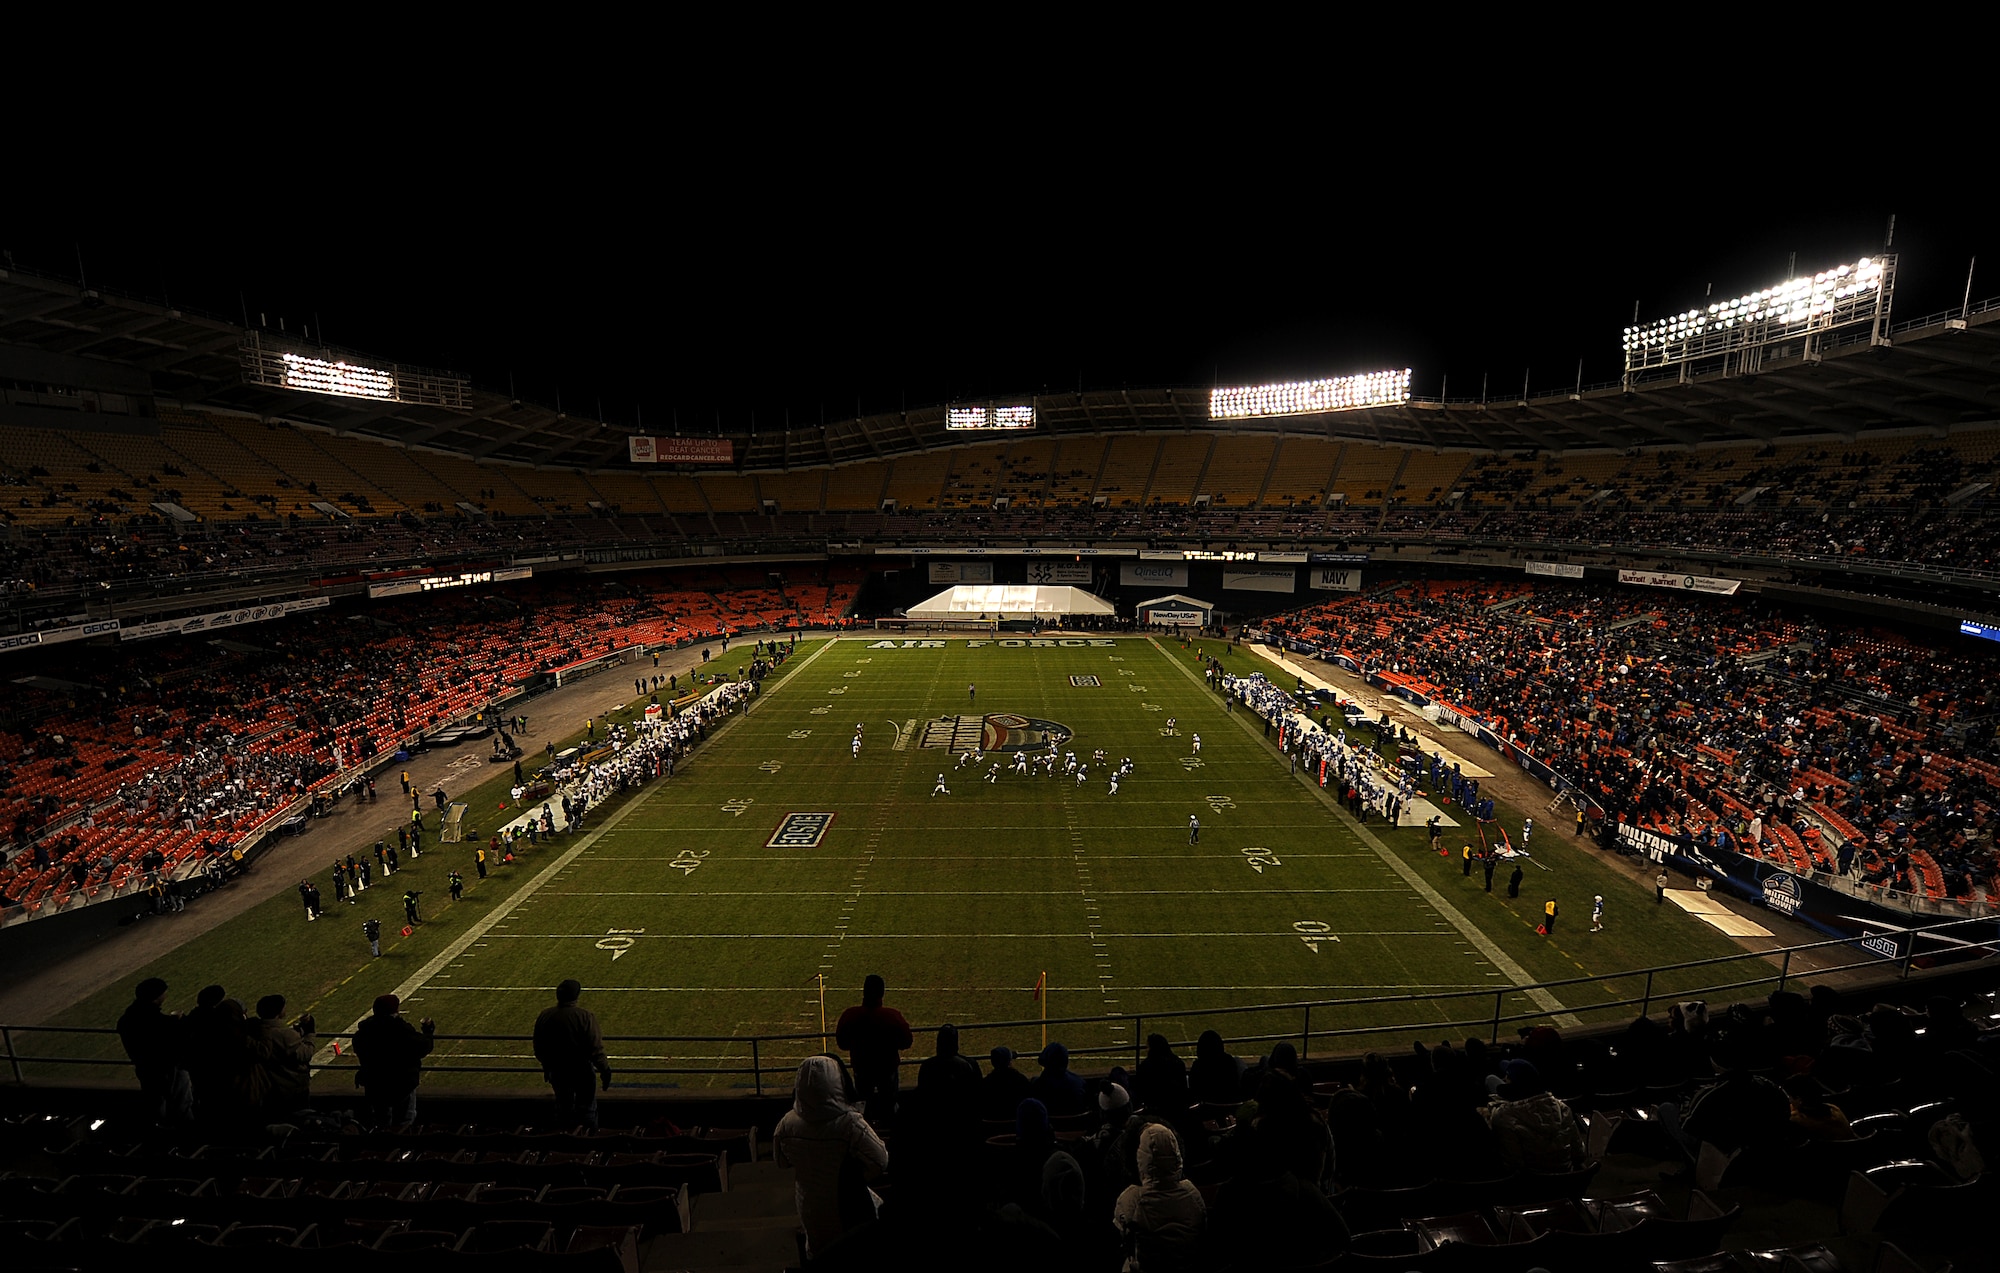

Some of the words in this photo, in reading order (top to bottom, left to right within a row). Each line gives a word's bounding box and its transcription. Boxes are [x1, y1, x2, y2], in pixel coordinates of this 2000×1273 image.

[1135, 566, 1173, 577] QinetiQ
[1322, 570, 1349, 584] NAVY
[1621, 574, 1646, 583] Marriott
[1650, 577, 1677, 586] Marriott
[0, 635, 38, 648] GEICO
[83, 621, 119, 634] GEICO
[866, 639, 947, 649] AIR
[966, 638, 1118, 648] FORCE
[923, 722, 955, 748] BOWL
[1459, 716, 1480, 738] BOWL
[720, 798, 754, 812] 30
[1205, 795, 1237, 809] 30
[781, 819, 823, 840] USO
[1617, 822, 1679, 856] MILITARY
[669, 849, 711, 868] 20
[1240, 847, 1282, 866] 20
[1764, 888, 1801, 907] MILITARY
[1769, 896, 1792, 911] BOWL
[594, 927, 646, 950] 10
[1292, 920, 1341, 943] 10
[1869, 938, 1891, 953] USO
